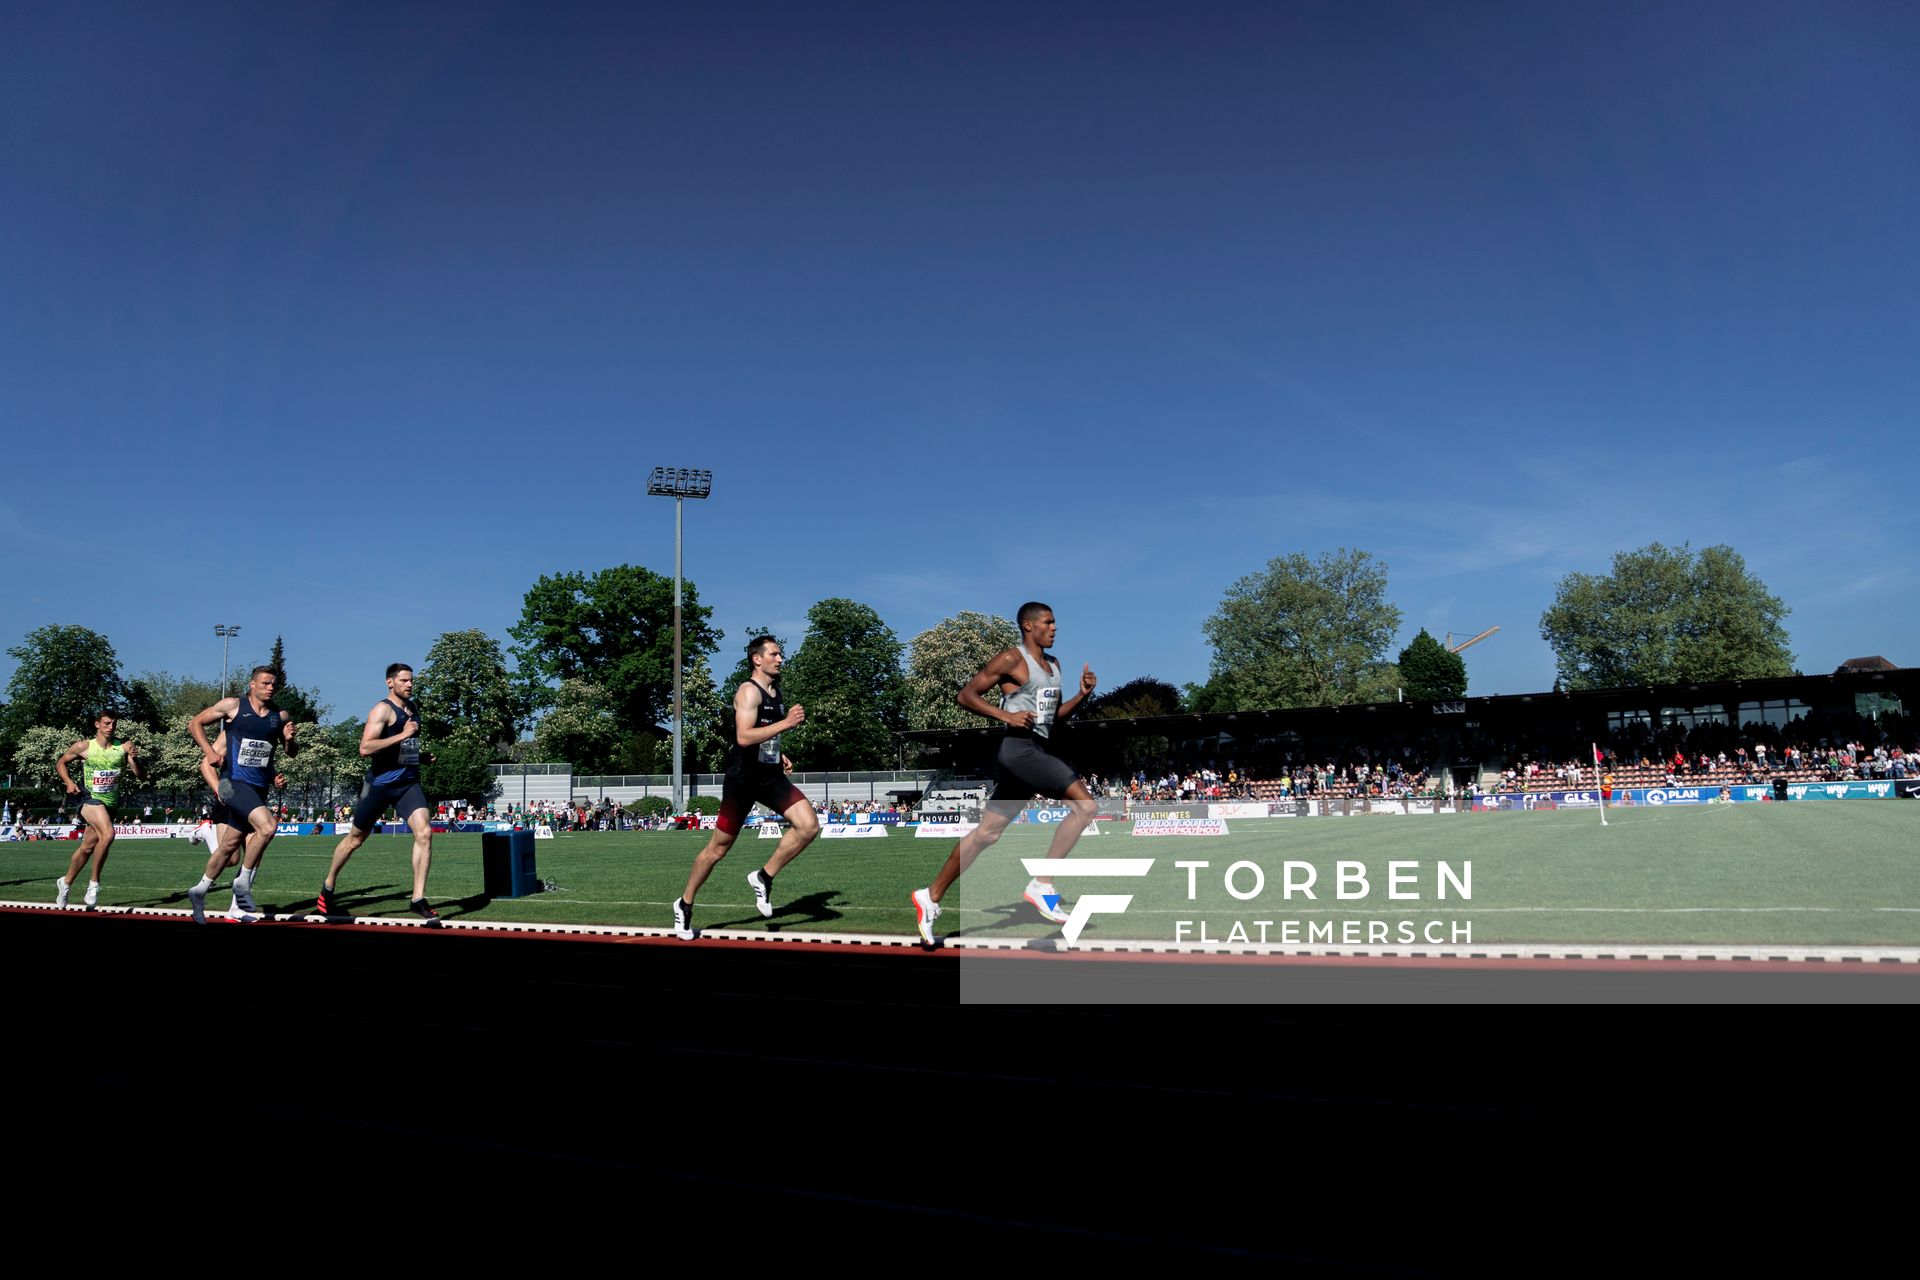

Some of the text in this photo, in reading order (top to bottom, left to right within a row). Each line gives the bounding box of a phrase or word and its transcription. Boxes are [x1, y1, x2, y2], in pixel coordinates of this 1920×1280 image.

[248, 741, 265, 749] GLS
[241, 748, 270, 758] BECKERS
[1668, 789, 1700, 799] PLAN
[140, 827, 168, 835] Forest
[542, 828, 551, 837] 40
[770, 826, 779, 835] 50
